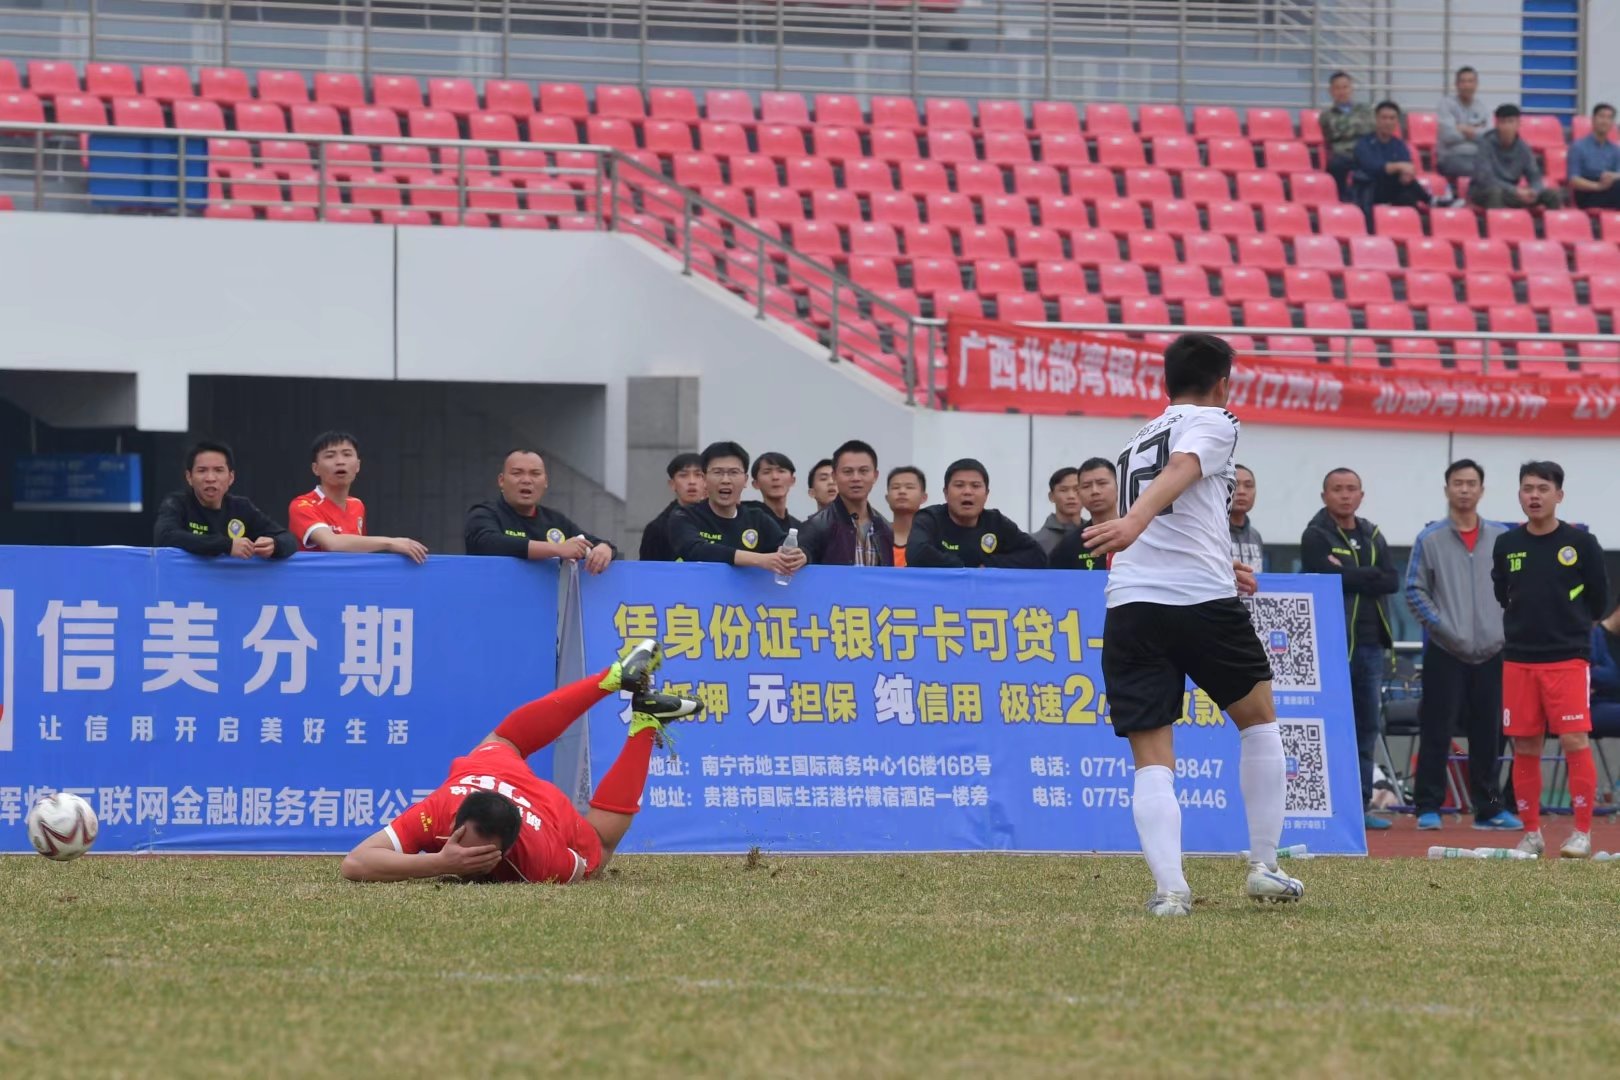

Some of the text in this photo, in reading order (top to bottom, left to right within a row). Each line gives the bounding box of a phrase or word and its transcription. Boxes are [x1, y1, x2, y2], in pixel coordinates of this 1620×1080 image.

[1117, 428, 1173, 518] 12
[1510, 558, 1522, 572] 18
[37, 600, 414, 697] 信美分期
[613, 603, 1103, 663] 凭身份证+银行卡可贷1-
[748, 673, 857, 724] 无担保
[873, 673, 983, 724] 纯信用
[38, 715, 409, 745] 让信用开启美好生活
[0, 785, 434, 828] 辉联网金融服务有限公
